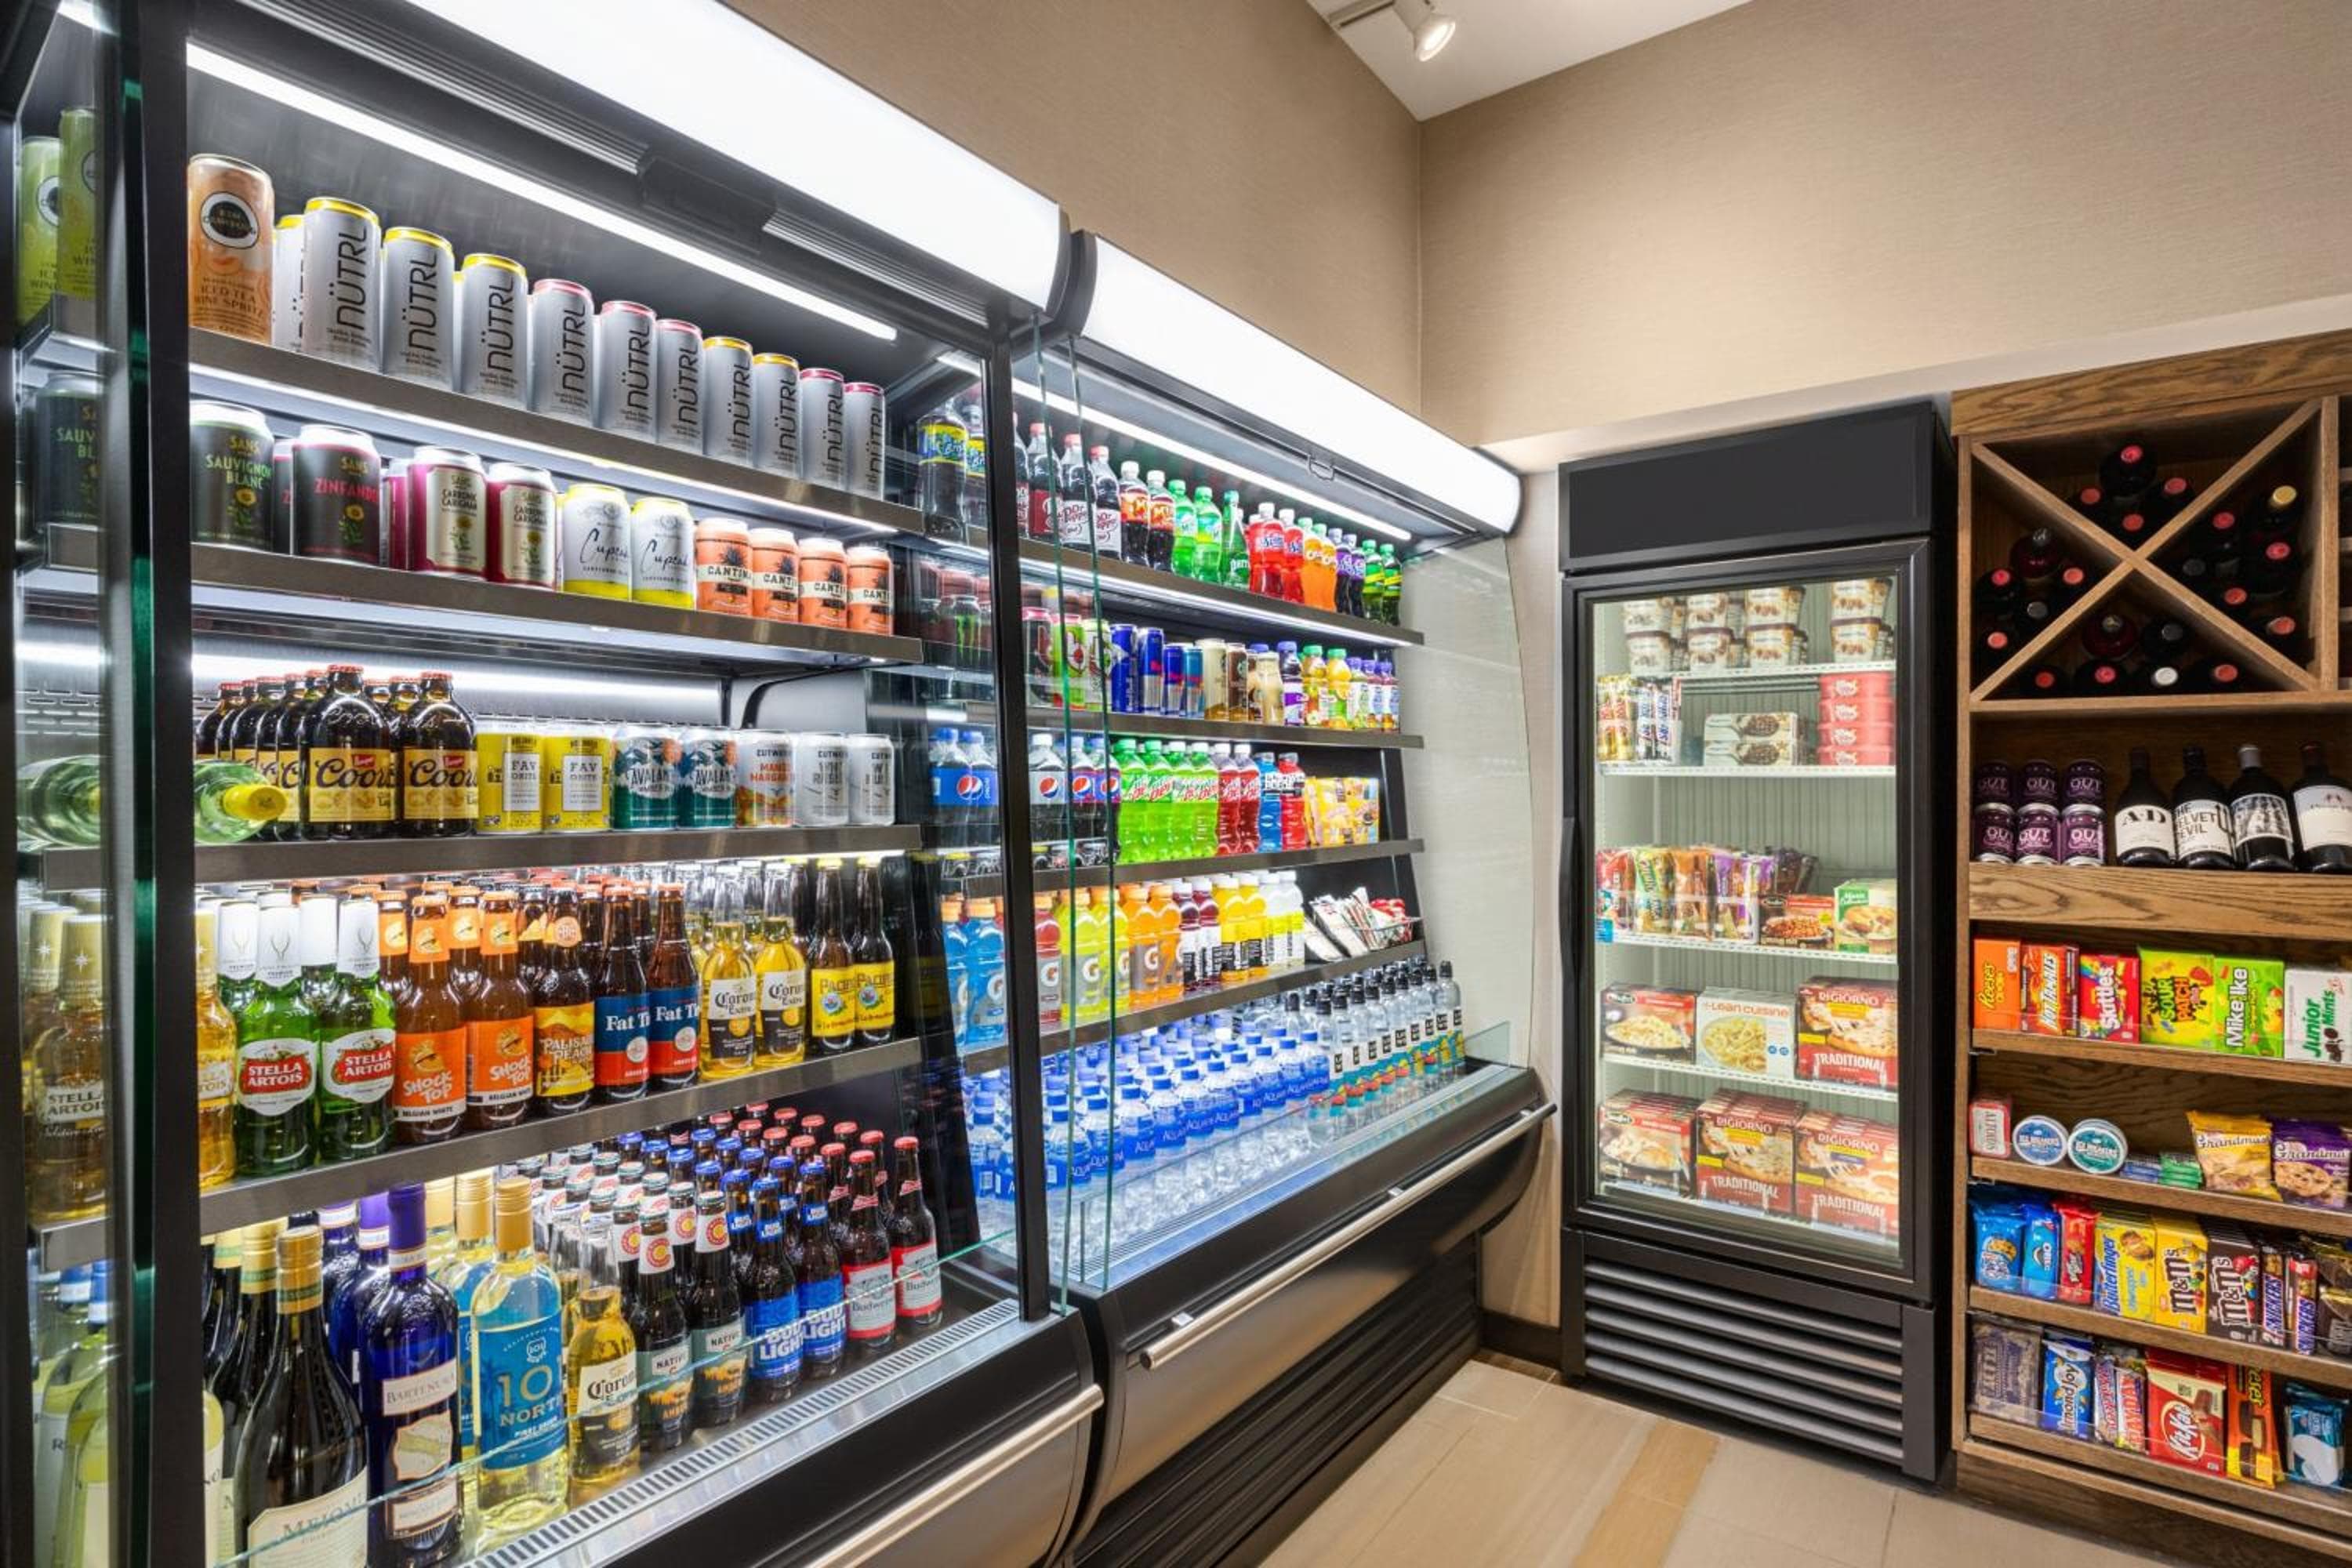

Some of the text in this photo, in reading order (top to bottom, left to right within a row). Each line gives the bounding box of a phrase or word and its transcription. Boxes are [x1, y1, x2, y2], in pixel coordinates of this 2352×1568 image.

[2157, 977, 2176, 1022] SOUR
[2173, 975, 2195, 1022] PATCH
[2322, 989, 2336, 1026] Mints
[606, 1014, 633, 1032] Fat
[655, 1004, 681, 1022] Fat
[2224, 998, 2245, 1049] Mike
[2302, 997, 2321, 1058] Junior
[249, 1062, 303, 1076] STELLA
[343, 1060, 391, 1078] ARTOIS
[345, 1049, 391, 1066] STELLA
[247, 1072, 303, 1087] ARTOIS
[403, 1071, 452, 1096] SHOCK
[423, 1083, 452, 1104] TOP
[2042, 1242, 2053, 1272] OREO
[802, 1315, 846, 1339] LIGHT
[759, 1336, 804, 1359] LIGHT
[497, 1364, 553, 1406] 10
[2063, 1364, 2080, 1387] Joy
